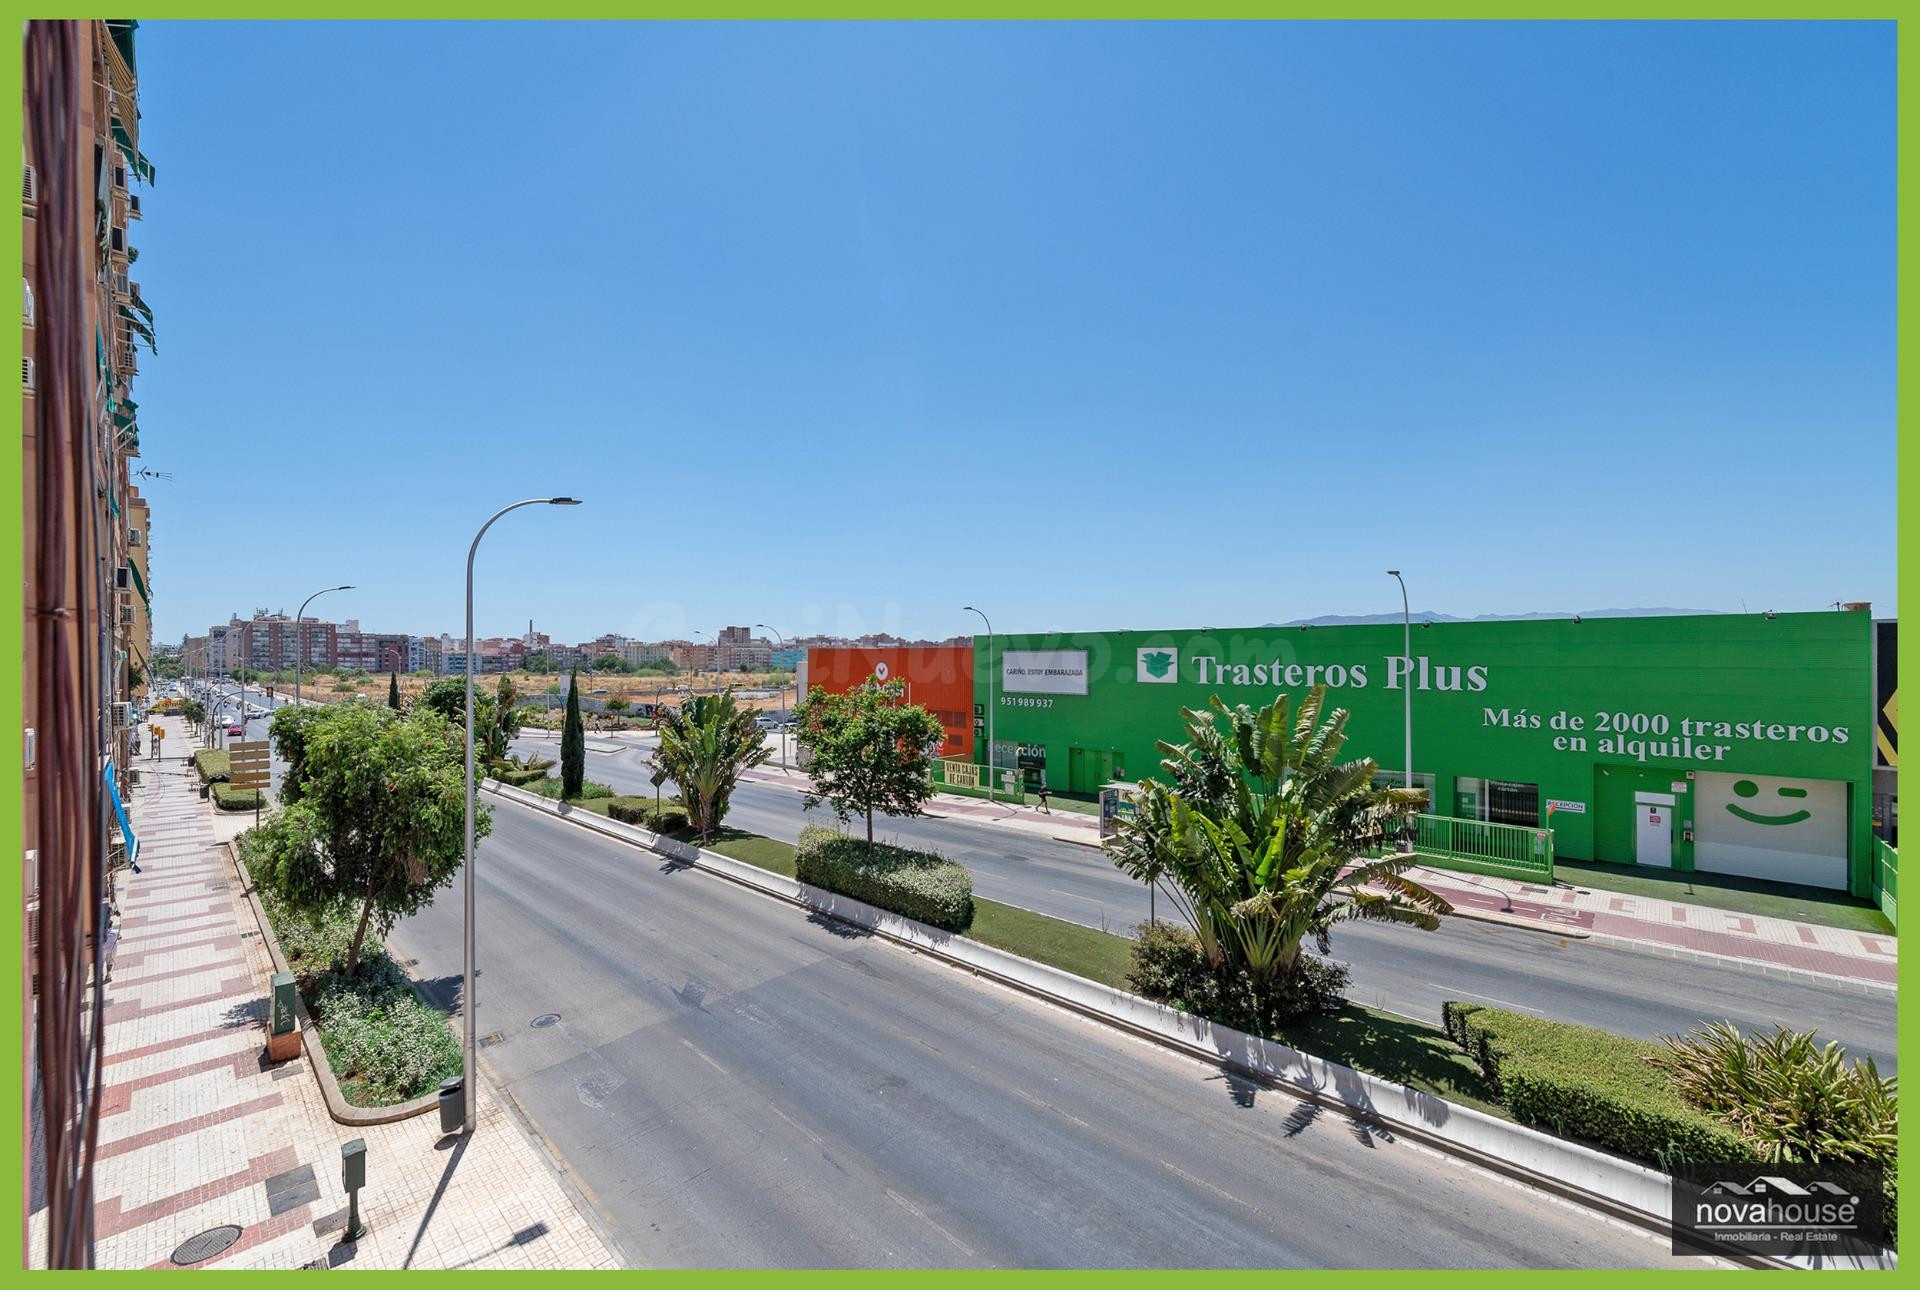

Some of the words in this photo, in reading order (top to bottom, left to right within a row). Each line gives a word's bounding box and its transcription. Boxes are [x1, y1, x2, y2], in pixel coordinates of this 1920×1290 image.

[1028, 668, 1043, 676] ESTOY
[1044, 668, 1083, 676] EMBARAZADA
[1191, 655, 1368, 688] Trasteros
[1383, 655, 1489, 692] Plus
[1036, 698, 1053, 708] 937
[1482, 707, 1541, 729] Más
[1549, 711, 1585, 731] de
[1594, 711, 1670, 736] 2000
[1680, 716, 1849, 744] trasteros
[1553, 735, 1588, 752] en
[1597, 734, 1731, 762] alquiler
[946, 761, 961, 774] VENTA
[961, 764, 978, 777] CAJAS
[949, 773, 956, 784] DE
